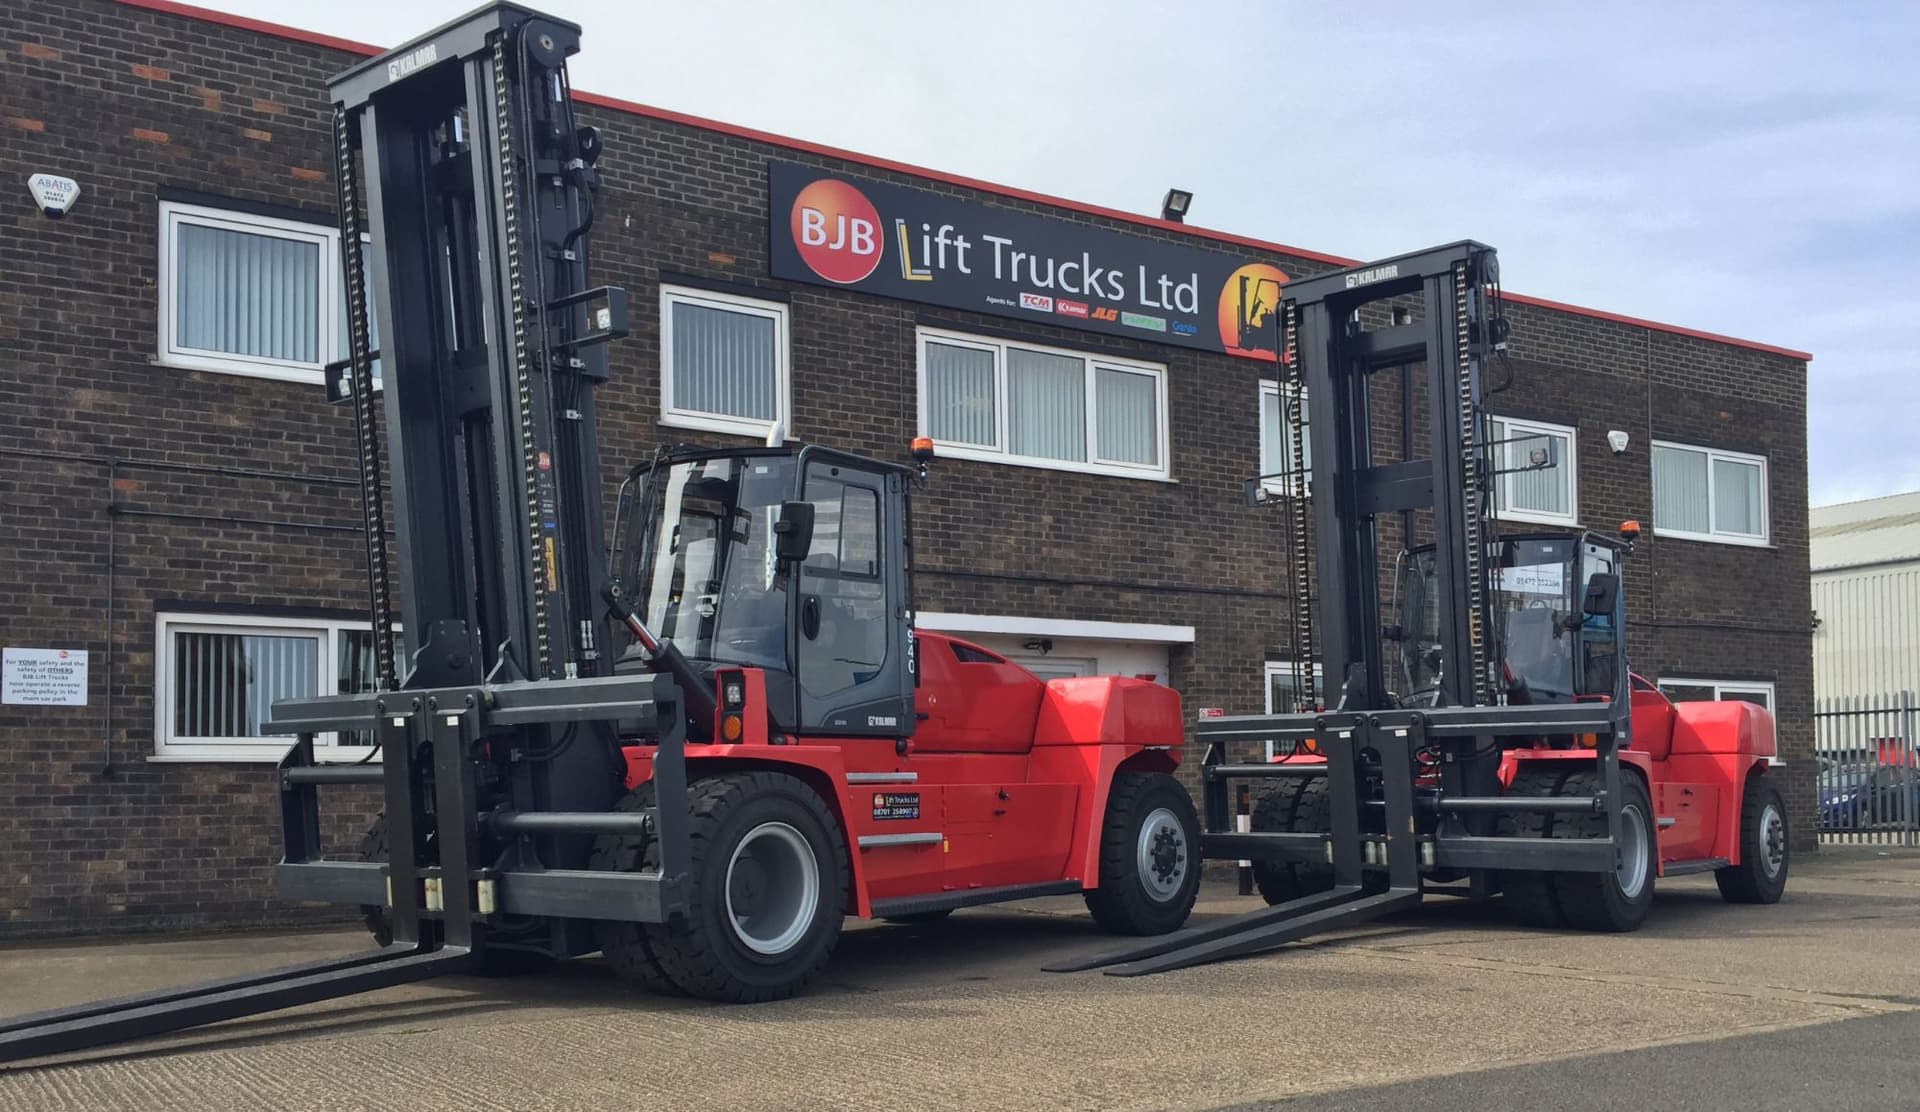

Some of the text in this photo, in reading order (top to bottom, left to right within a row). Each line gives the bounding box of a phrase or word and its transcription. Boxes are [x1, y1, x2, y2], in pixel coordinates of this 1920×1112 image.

[400, 44, 437, 76] KALMAR
[38, 178, 73, 191] ABATIS
[802, 207, 875, 256] BJB
[896, 218, 1198, 314] Lift Trucks Ltd
[1358, 265, 1397, 285] KALMAR
[985, 295, 1006, 305] Agents
[1023, 295, 1049, 309] TCM
[1091, 307, 1118, 321] JLG
